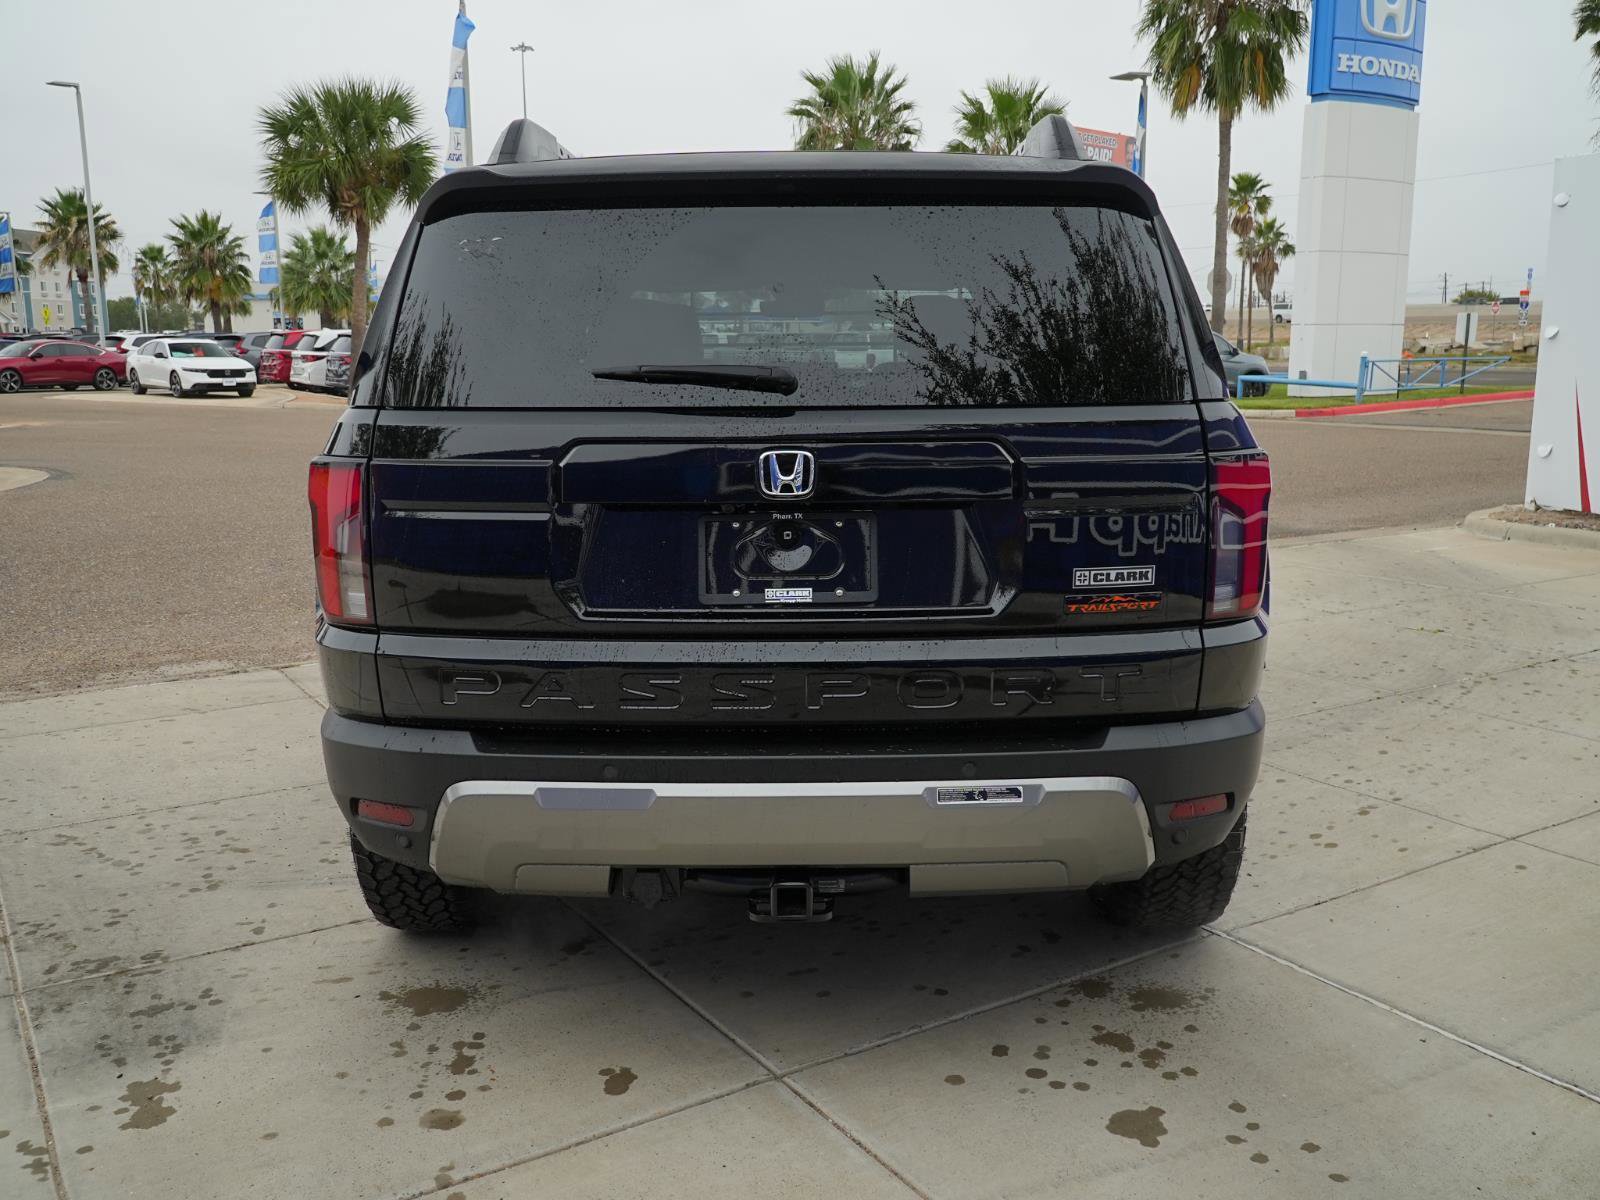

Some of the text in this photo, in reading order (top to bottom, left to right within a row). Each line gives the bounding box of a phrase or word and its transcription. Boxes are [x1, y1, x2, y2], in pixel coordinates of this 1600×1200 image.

[1337, 53, 1421, 83] HONDA
[794, 512, 803, 520] TX
[1093, 570, 1150, 583] CLARK
[1067, 601, 1161, 613] TRAILSPORT
[439, 664, 1143, 710] PASSPORT
